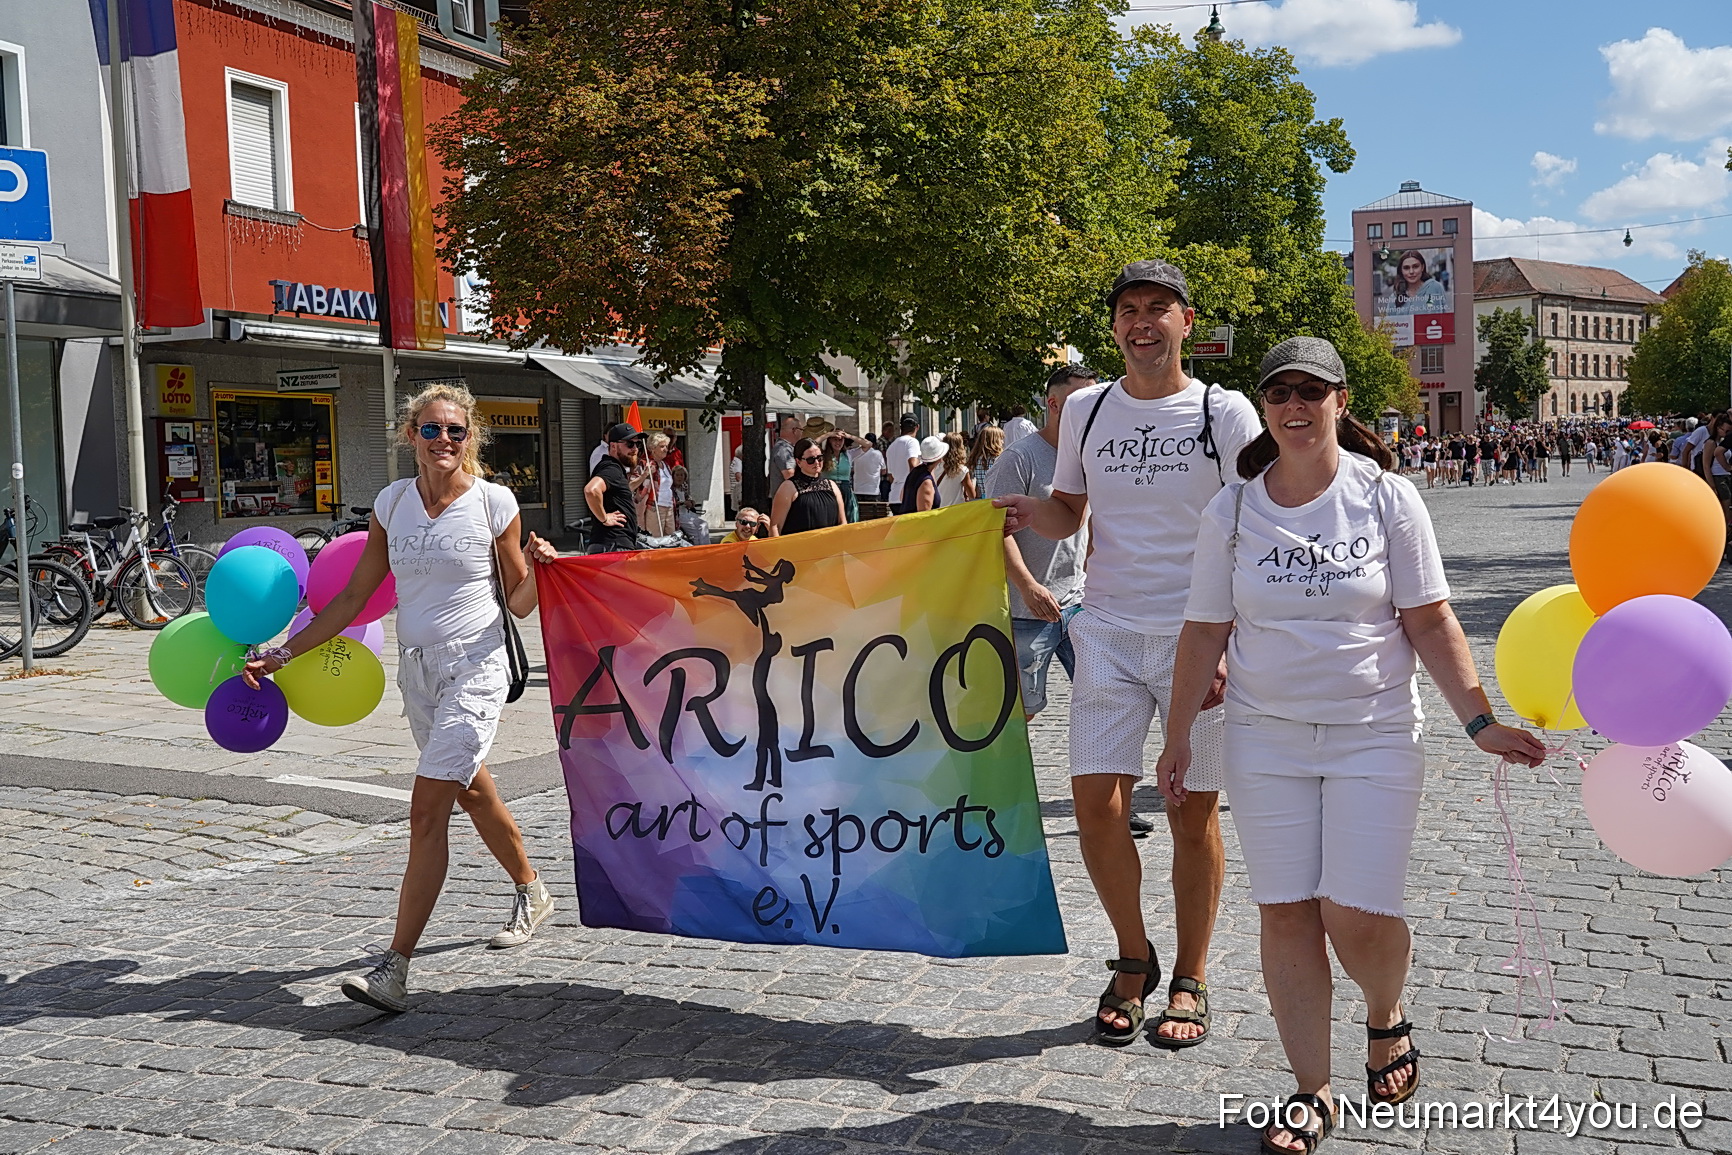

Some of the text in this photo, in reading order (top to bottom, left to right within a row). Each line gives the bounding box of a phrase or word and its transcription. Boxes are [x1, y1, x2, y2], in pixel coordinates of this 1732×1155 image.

[279, 376, 300, 388] NZ
[299, 373, 338, 381] NORDBAYERISCHE
[299, 379, 319, 387] ZEITUNG
[162, 393, 192, 404] LOTTO
[169, 406, 186, 415] Bayern
[490, 414, 539, 427] SCHLIERF
[1104, 462, 1190, 475] art of sports
[391, 555, 464, 567] art of sports
[1266, 565, 1367, 585] art of sports
[1660, 746, 1670, 758] art
[1641, 765, 1658, 790] sports
[604, 792, 1006, 876] art of sports
